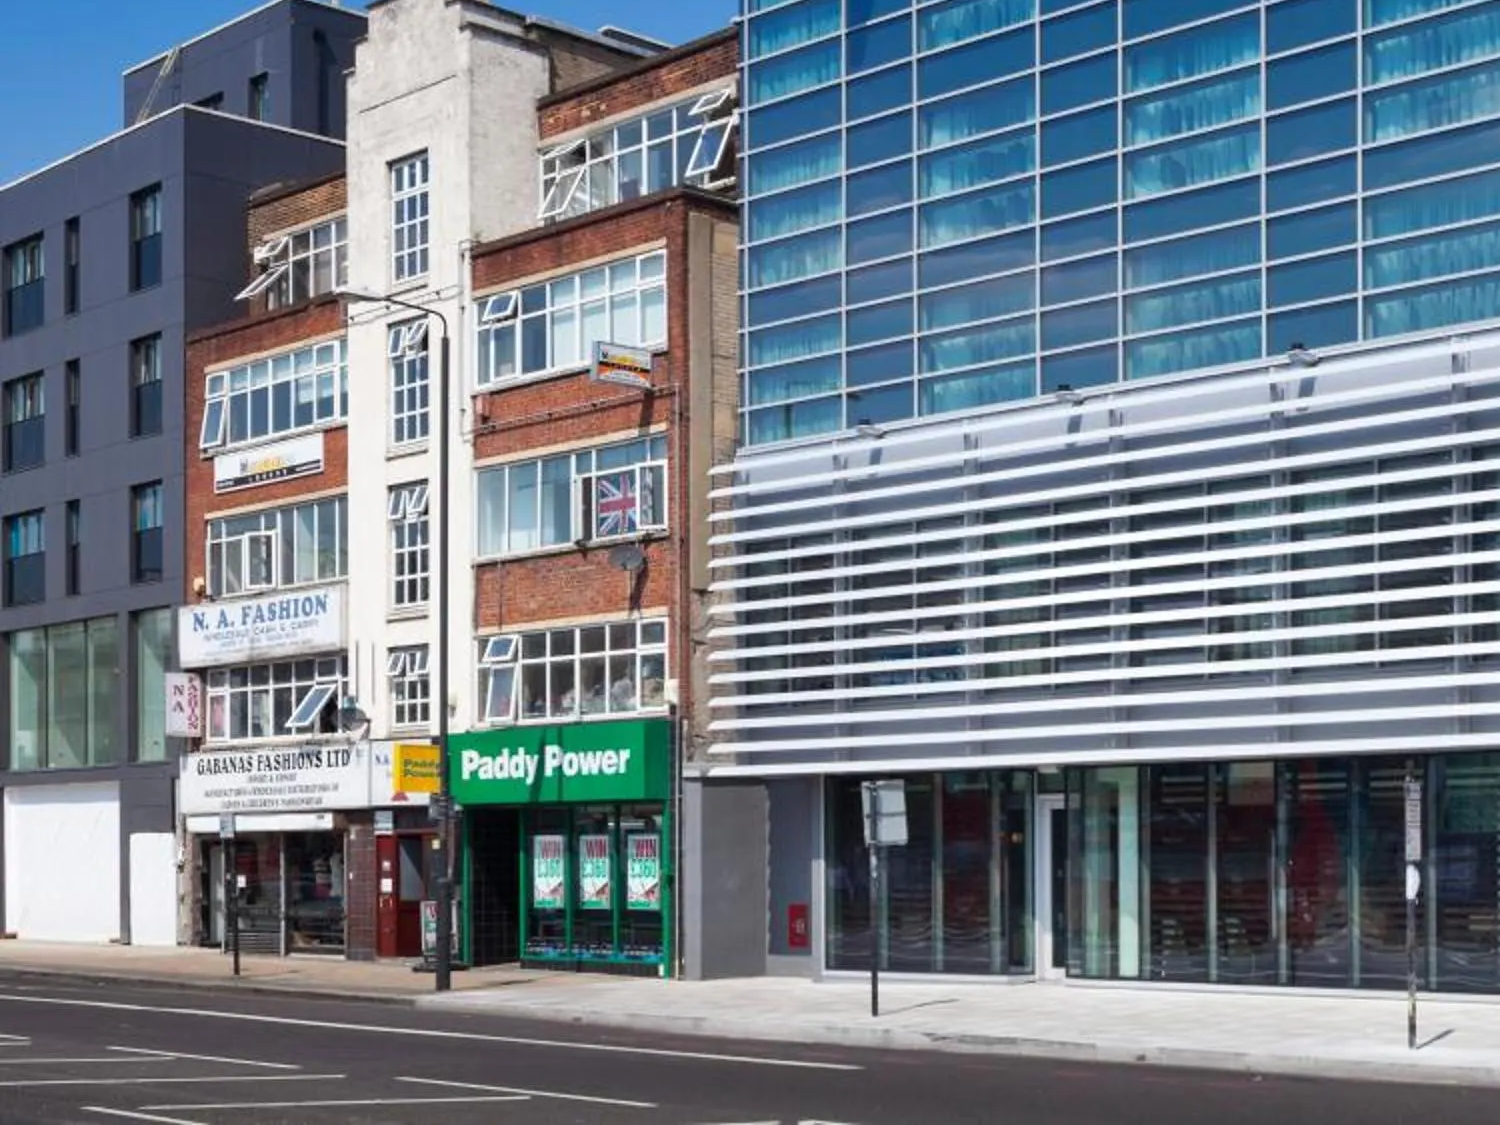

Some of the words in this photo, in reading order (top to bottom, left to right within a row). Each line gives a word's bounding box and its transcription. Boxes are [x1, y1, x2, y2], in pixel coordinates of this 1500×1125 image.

[193, 611, 209, 632] N.
[217, 608, 235, 629] A.
[241, 593, 329, 626] FASHION
[257, 750, 323, 772] FASHIONS
[327, 748, 351, 768] LTD
[461, 747, 539, 786] Paddy
[544, 744, 631, 777] Power
